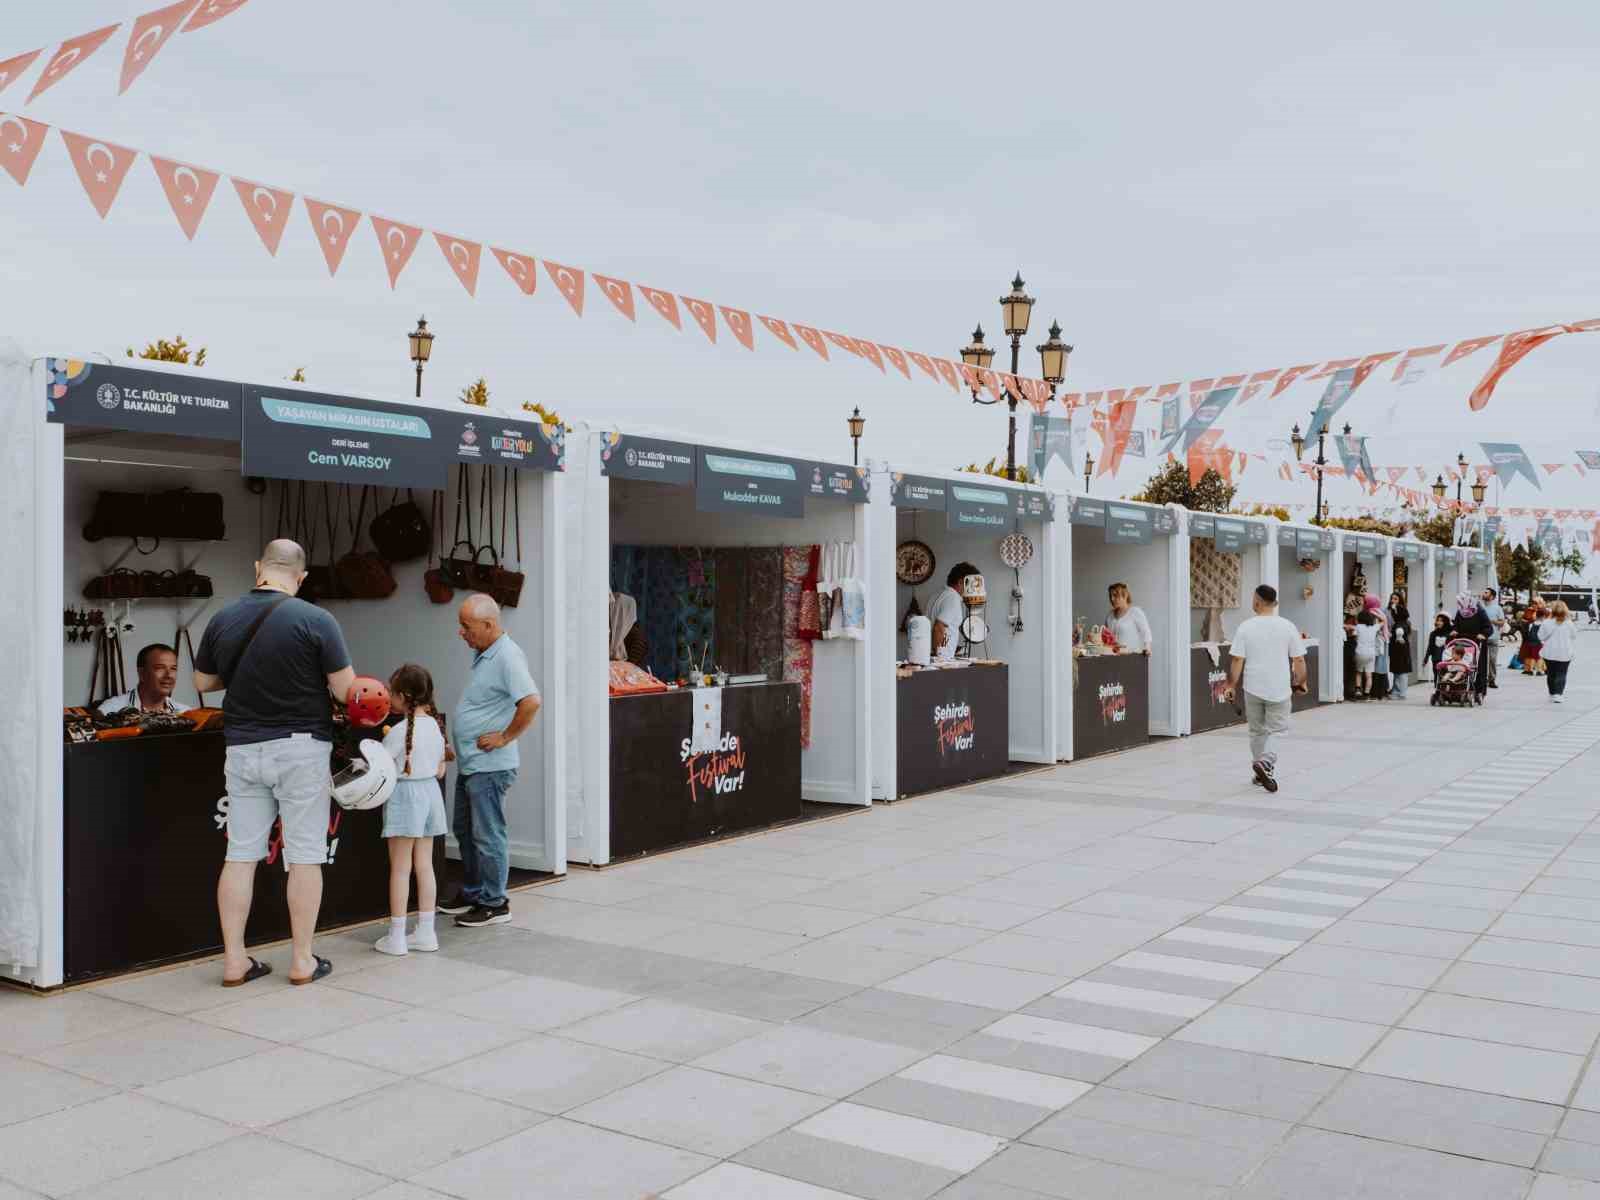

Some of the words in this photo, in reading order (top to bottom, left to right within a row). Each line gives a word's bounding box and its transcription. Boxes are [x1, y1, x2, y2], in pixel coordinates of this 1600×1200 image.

[123, 388, 140, 399] T.C.
[142, 389, 179, 404] KÜLTÜR
[180, 395, 193, 405] VE
[194, 396, 229, 409] TURİZM
[123, 400, 176, 415] BAKANLIĞI
[308, 451, 338, 465] Cem
[341, 454, 392, 470] VARSOY
[934, 701, 969, 724] Şehirde
[954, 733, 973, 751] Var!
[714, 771, 745, 794] Var!
